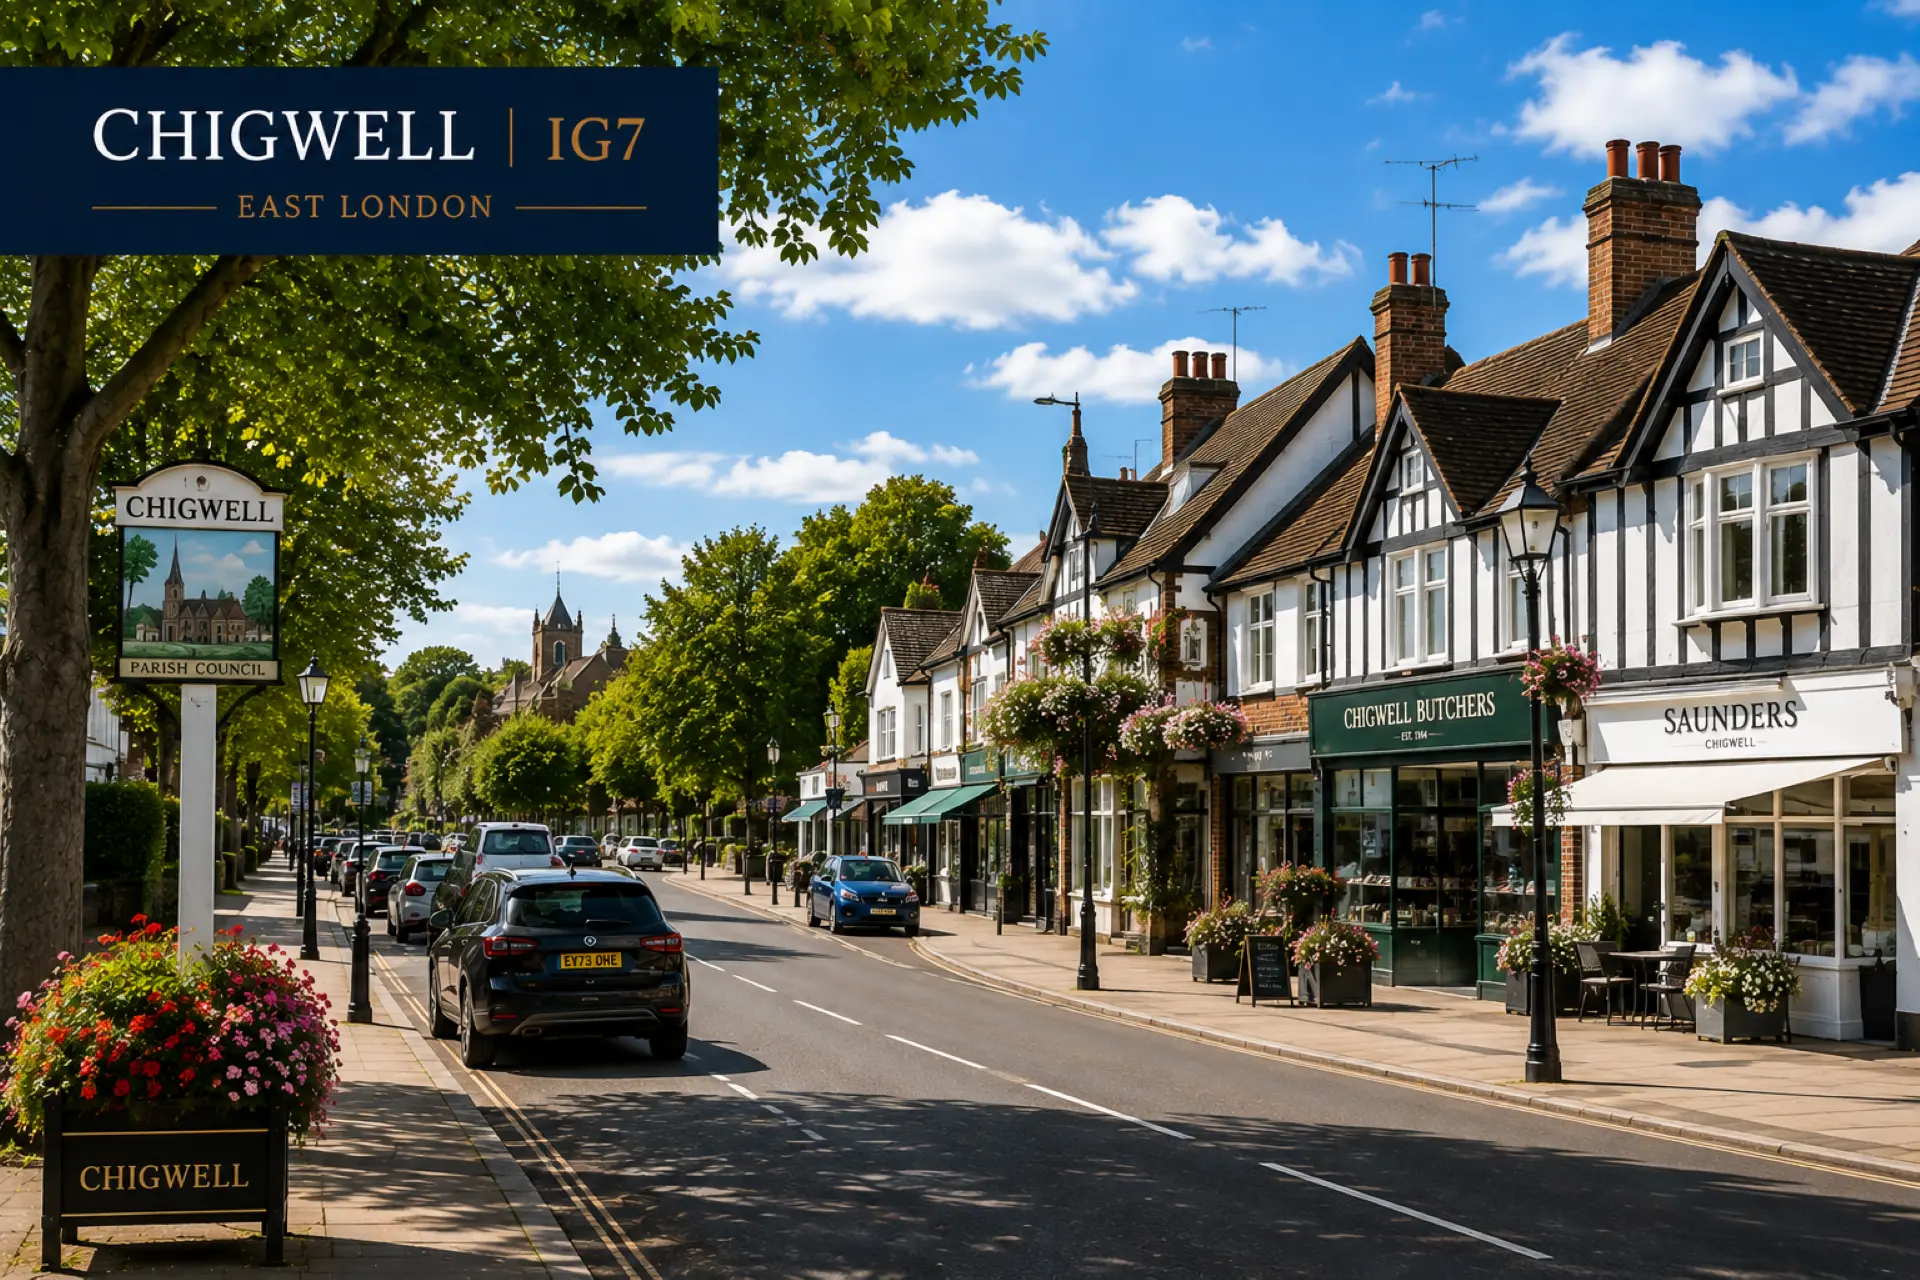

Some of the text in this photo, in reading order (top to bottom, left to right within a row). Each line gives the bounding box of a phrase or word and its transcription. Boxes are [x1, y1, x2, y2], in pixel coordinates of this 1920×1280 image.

[126, 496, 274, 523] CHIGWELL
[130, 661, 266, 677] PARISH COUNCIL
[1343, 691, 1496, 730] CHIGWELL BUTCHERS
[1664, 700, 1798, 735] SAUNDERS
[1705, 737, 1756, 749] CHIGWELL
[564, 955, 592, 967] EY73
[79, 1163, 250, 1191] CHIGWELL
